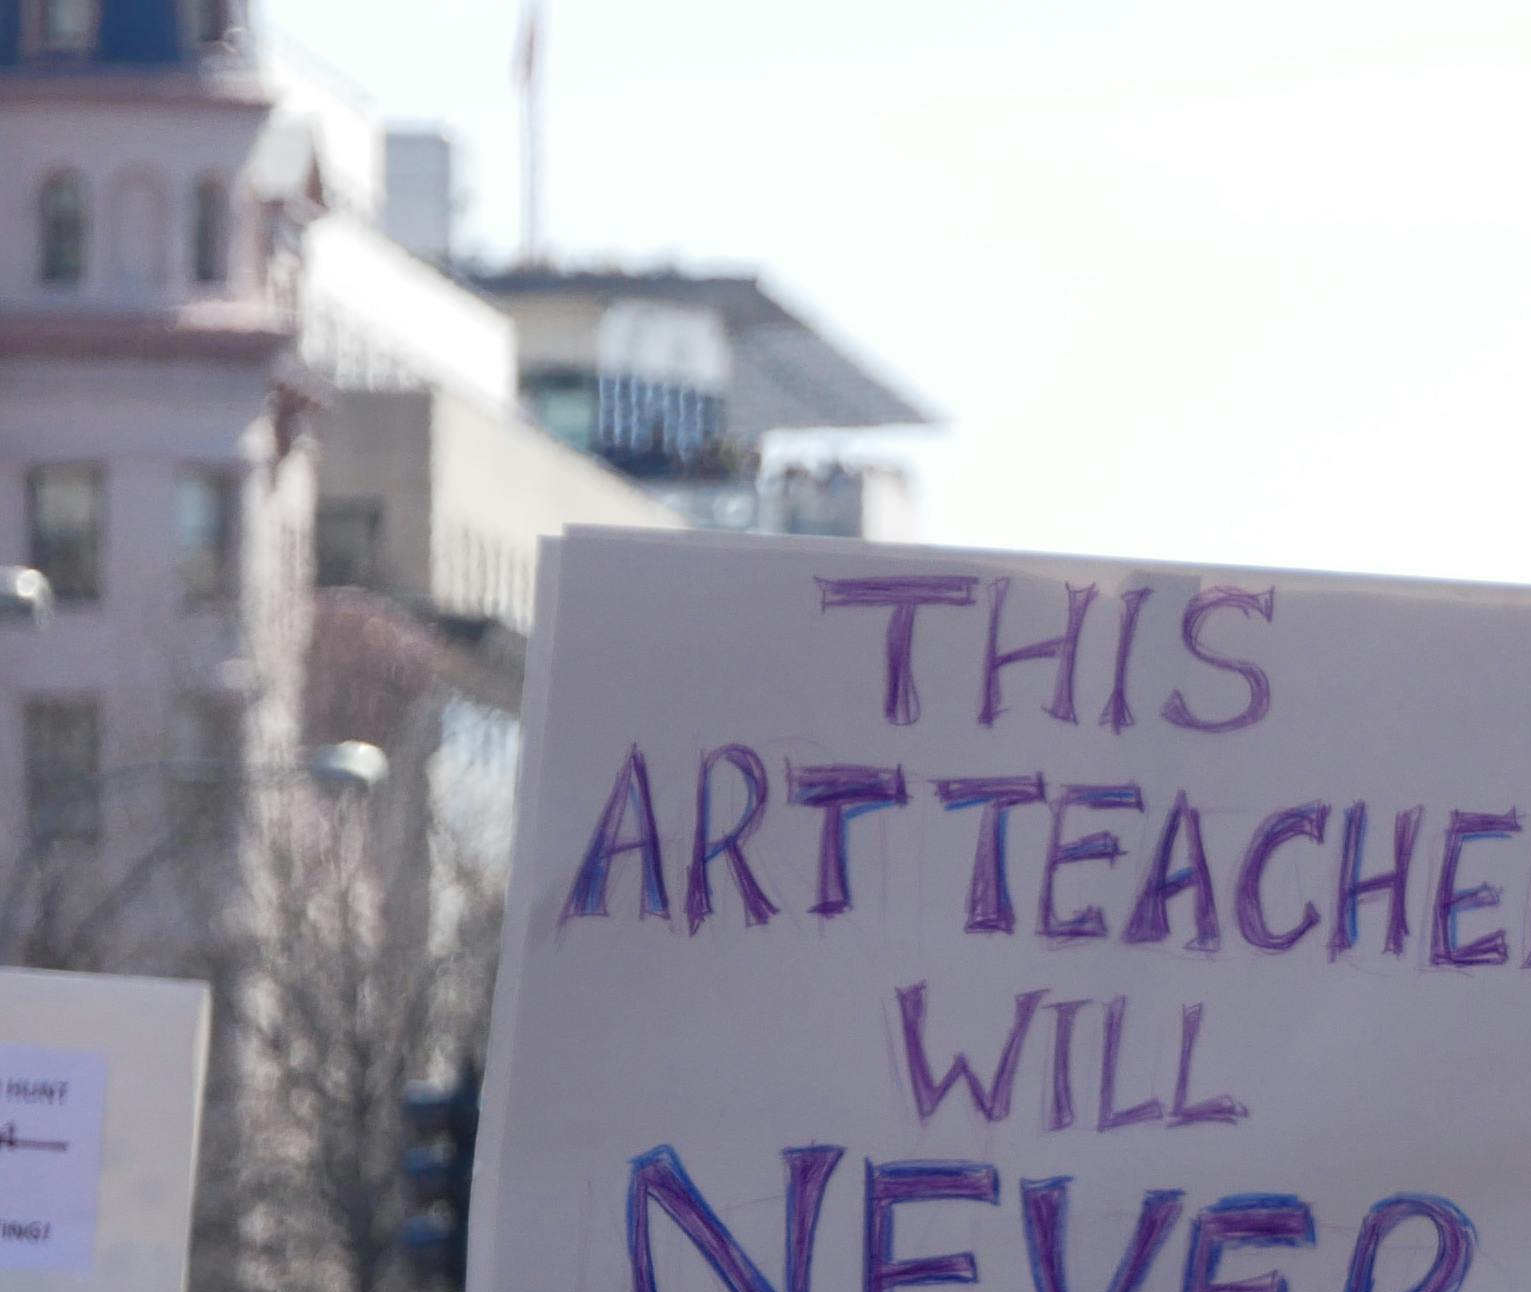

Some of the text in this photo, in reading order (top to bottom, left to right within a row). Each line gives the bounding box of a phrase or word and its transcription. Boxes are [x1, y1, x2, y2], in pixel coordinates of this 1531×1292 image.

[813, 574, 1275, 735] THIS
[556, 742, 911, 936] ART
[894, 979, 1248, 1134] WILL
[0, 1219, 51, 1244] ING!
